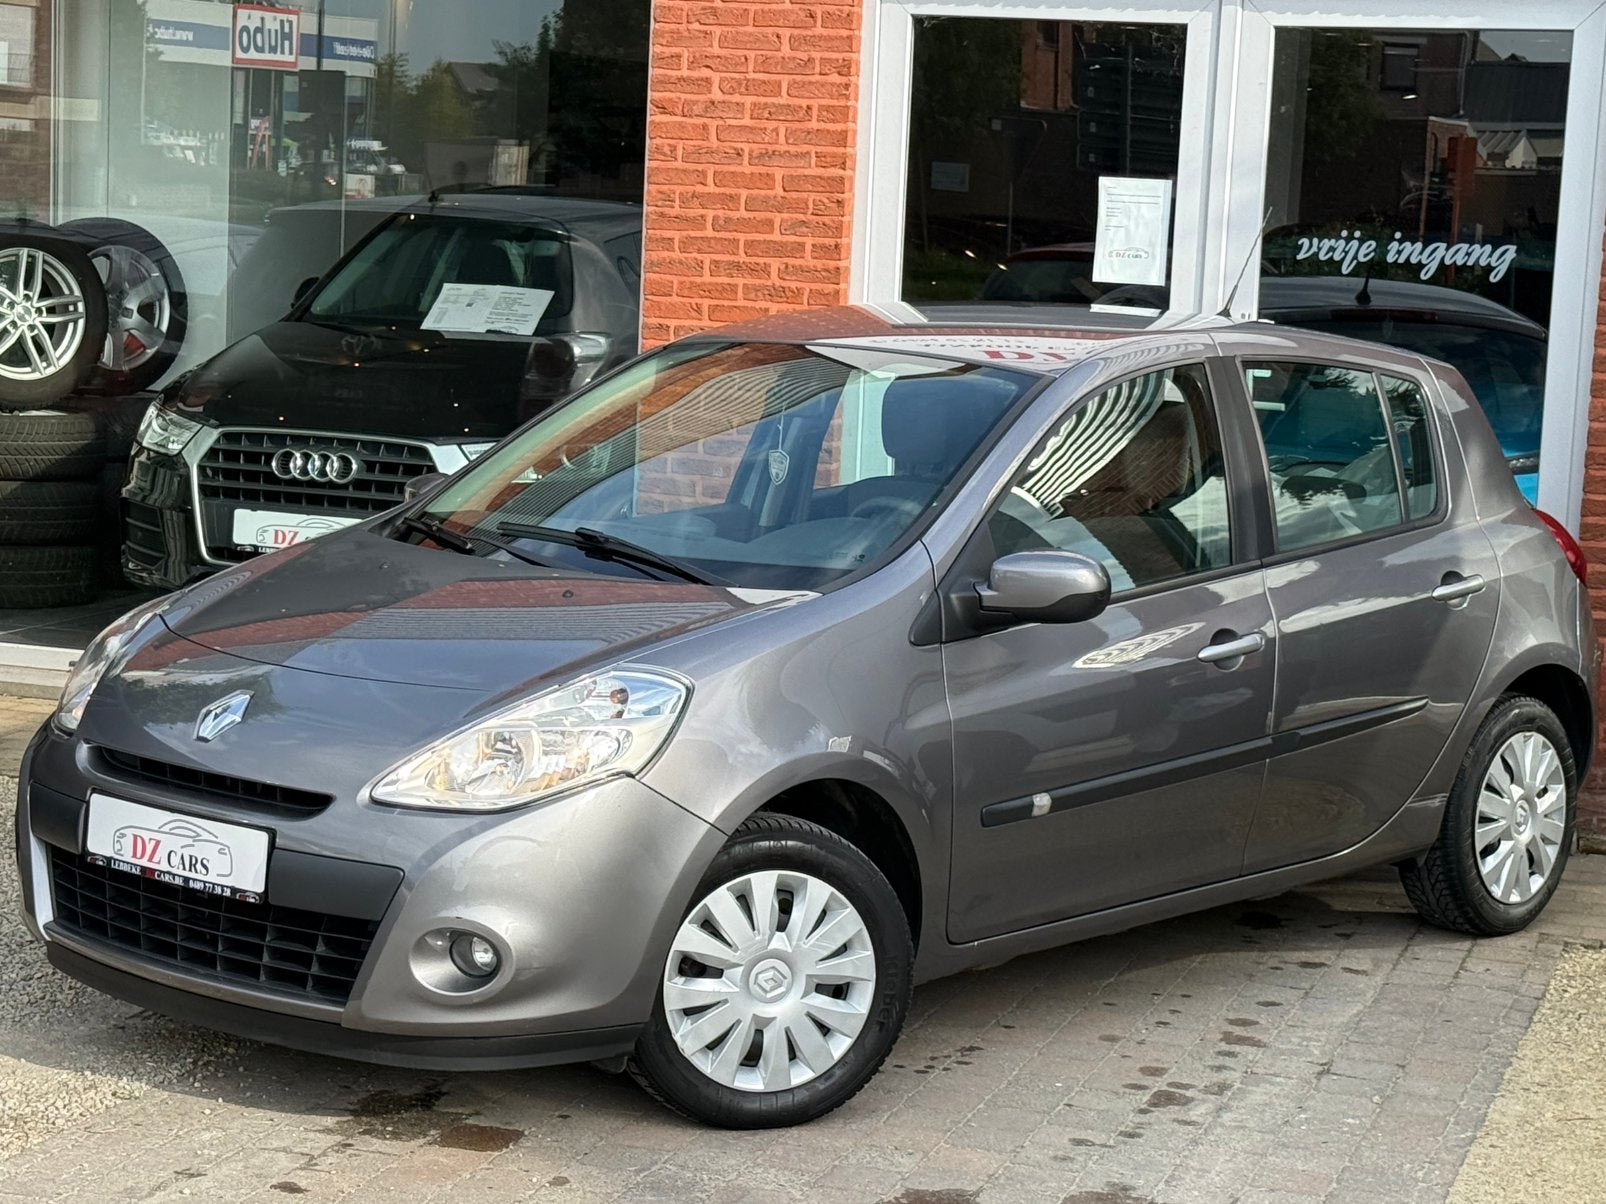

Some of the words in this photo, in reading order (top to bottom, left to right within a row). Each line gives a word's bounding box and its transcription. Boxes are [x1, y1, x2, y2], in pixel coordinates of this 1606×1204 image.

[1296, 229, 1377, 275] vrije
[1386, 231, 1518, 283] ingang
[273, 529, 299, 546] DZ
[111, 859, 142, 876] LEBBEKE
[131, 833, 162, 865] DZ
[167, 849, 210, 876] CARS
